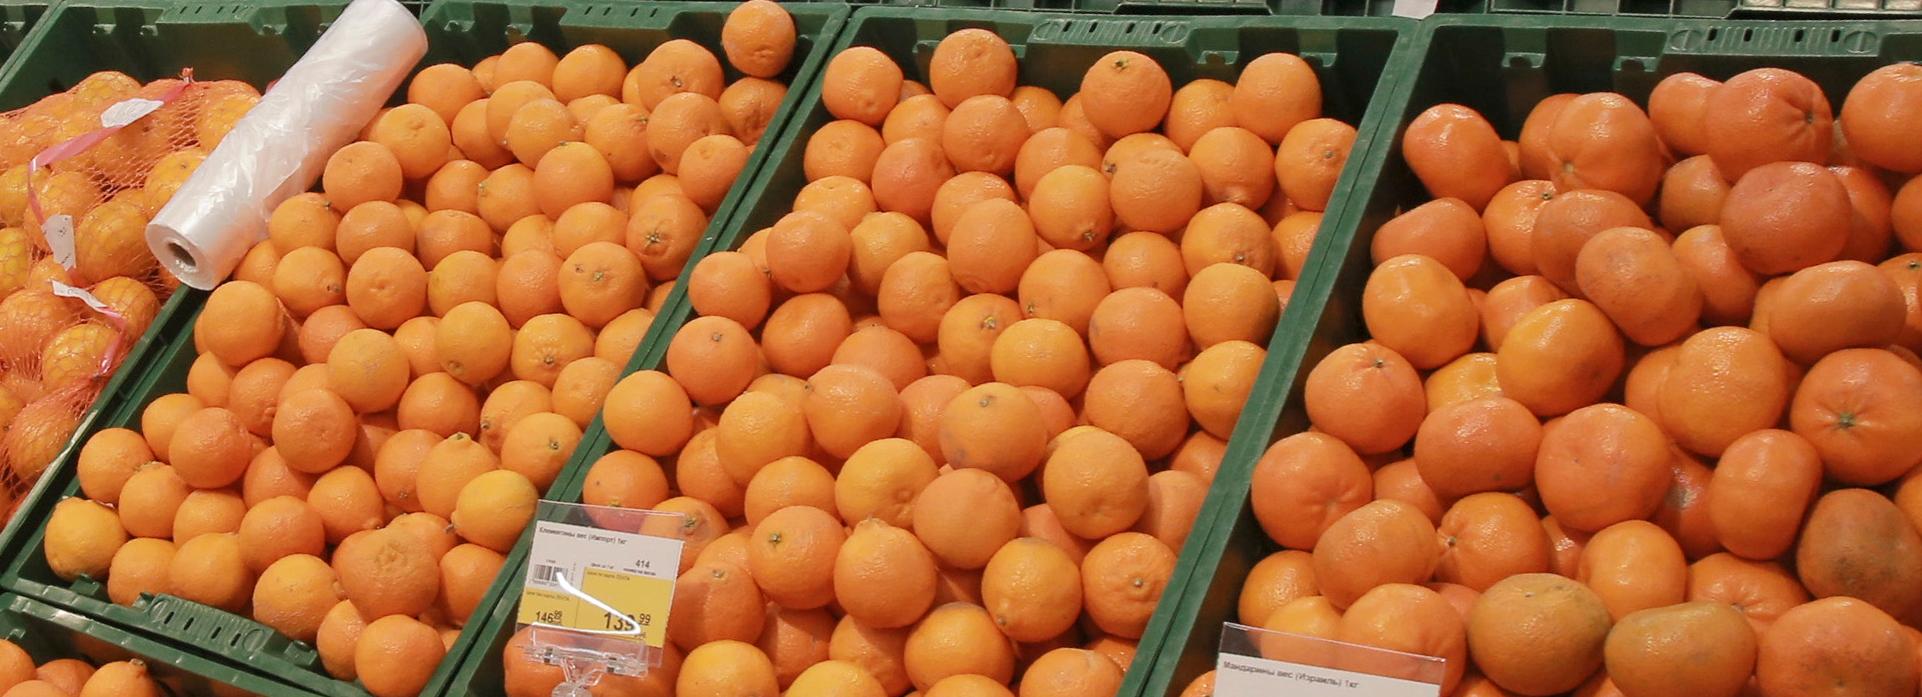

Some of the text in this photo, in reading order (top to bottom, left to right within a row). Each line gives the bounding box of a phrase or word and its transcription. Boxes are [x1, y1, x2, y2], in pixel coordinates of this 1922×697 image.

[635, 559, 650, 568] 414
[536, 610, 554, 623] 146
[639, 612, 651, 625] 99
[1223, 660, 1360, 689] Мандарины вес (Израиль) 1кг
